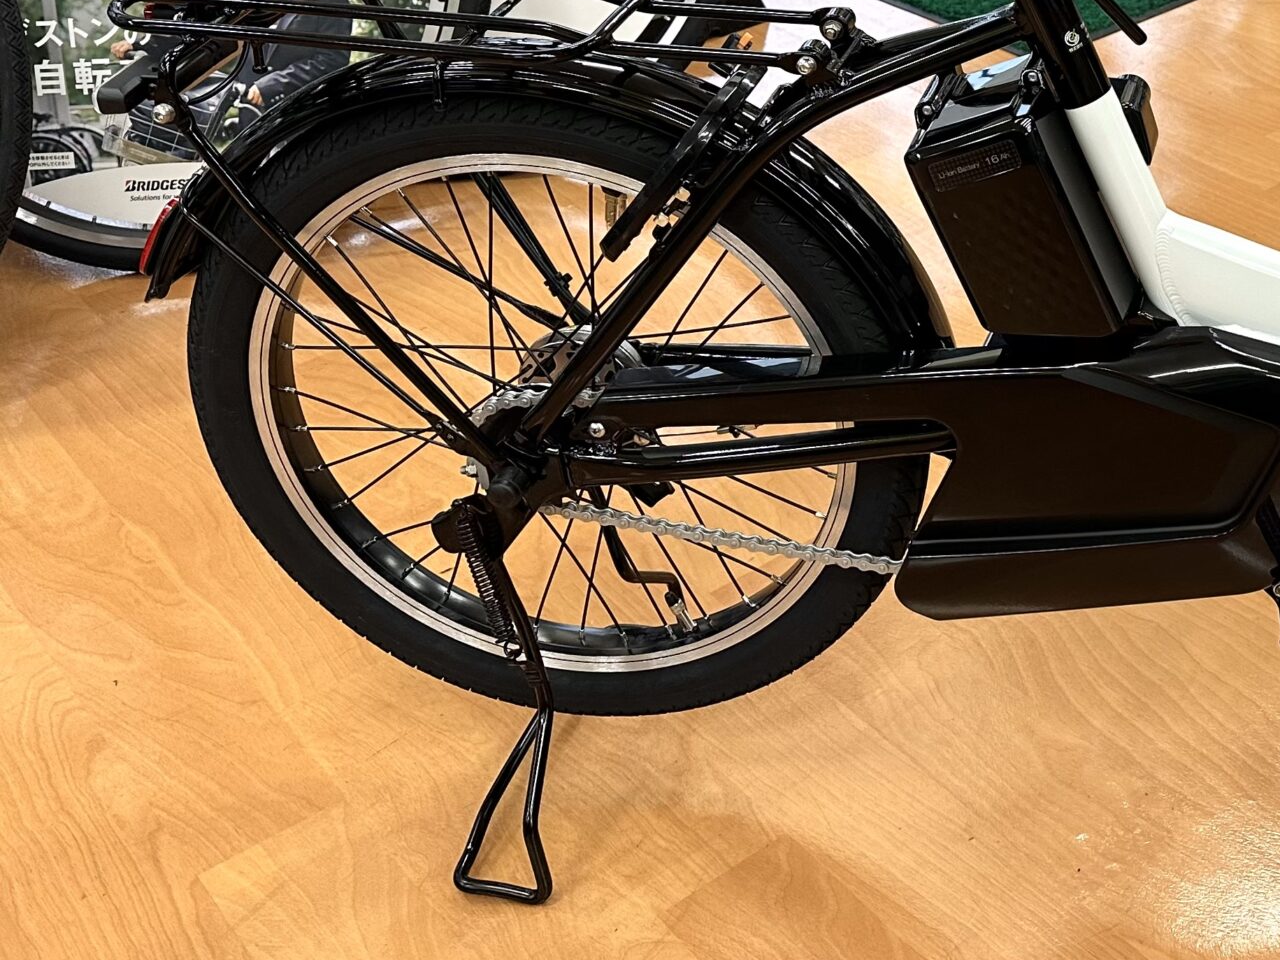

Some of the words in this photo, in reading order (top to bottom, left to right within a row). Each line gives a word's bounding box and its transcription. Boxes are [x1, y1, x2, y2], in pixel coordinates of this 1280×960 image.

[22, 18, 151, 48] ストンの
[34, 58, 136, 96] 自転
[984, 154, 1000, 166] 16
[130, 194, 160, 202] Solutions
